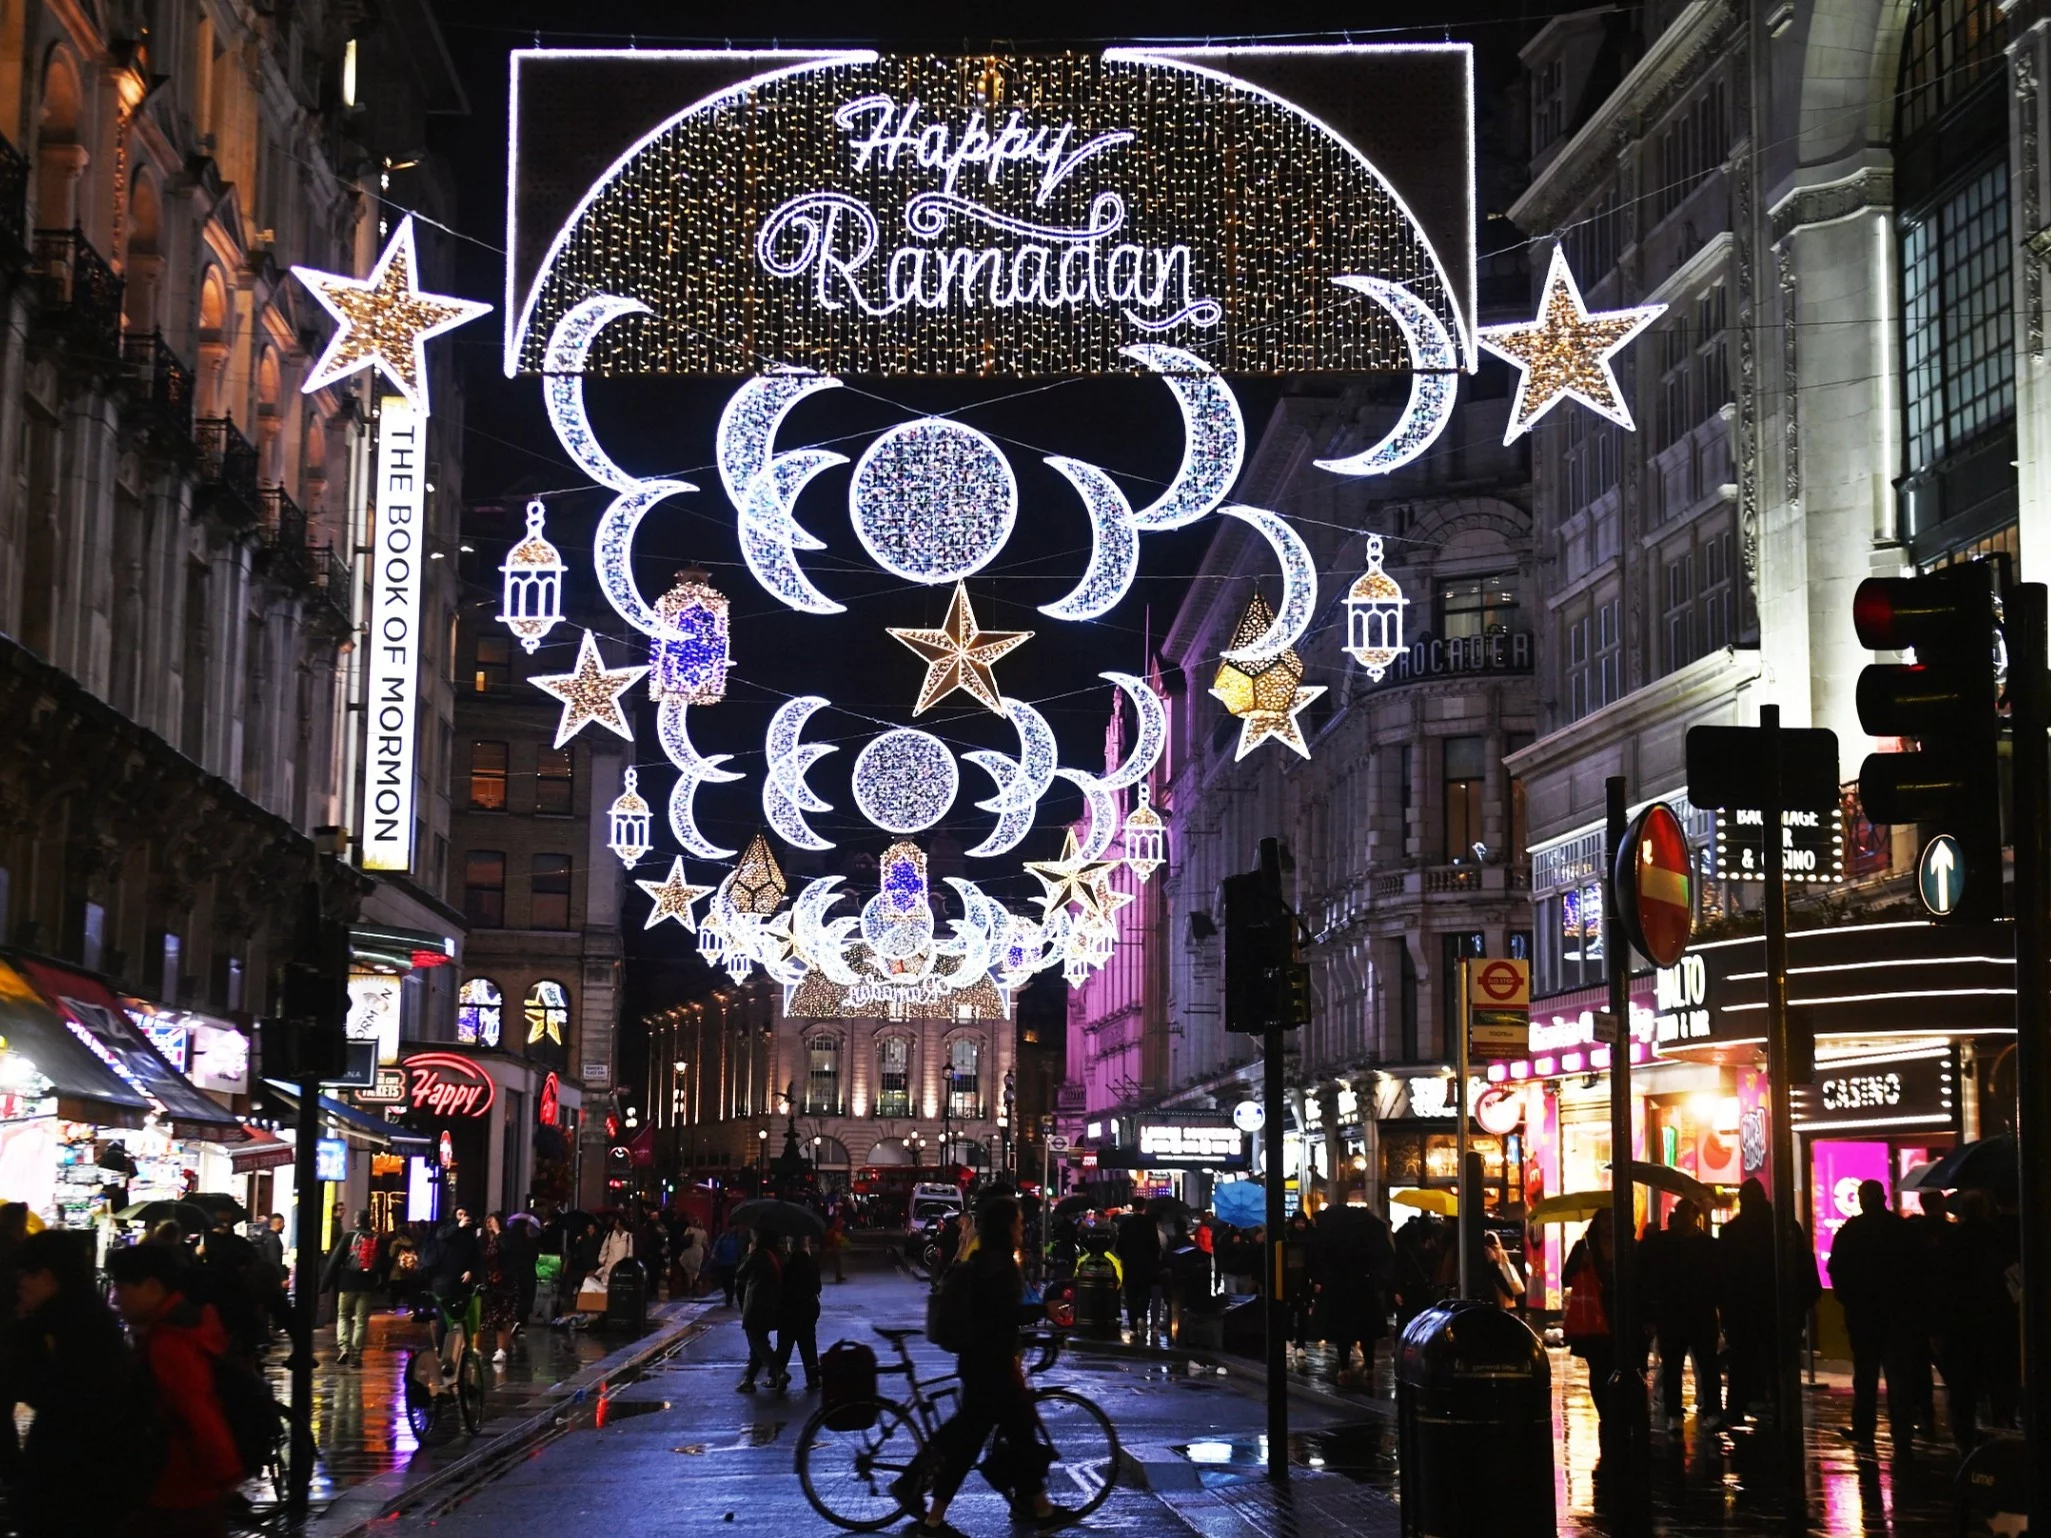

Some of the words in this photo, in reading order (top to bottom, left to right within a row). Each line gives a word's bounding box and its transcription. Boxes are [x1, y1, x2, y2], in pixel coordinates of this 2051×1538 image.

[834, 92, 1133, 207] Happy
[757, 189, 1224, 330] Ramadan
[387, 424, 416, 493] THE
[384, 504, 412, 606] BOOK
[382, 615, 408, 665] OF
[373, 677, 406, 843] MORMON
[1741, 848, 1755, 869] &
[411, 1068, 483, 1116] Happy
[1822, 1073, 1902, 1110] CASINO
